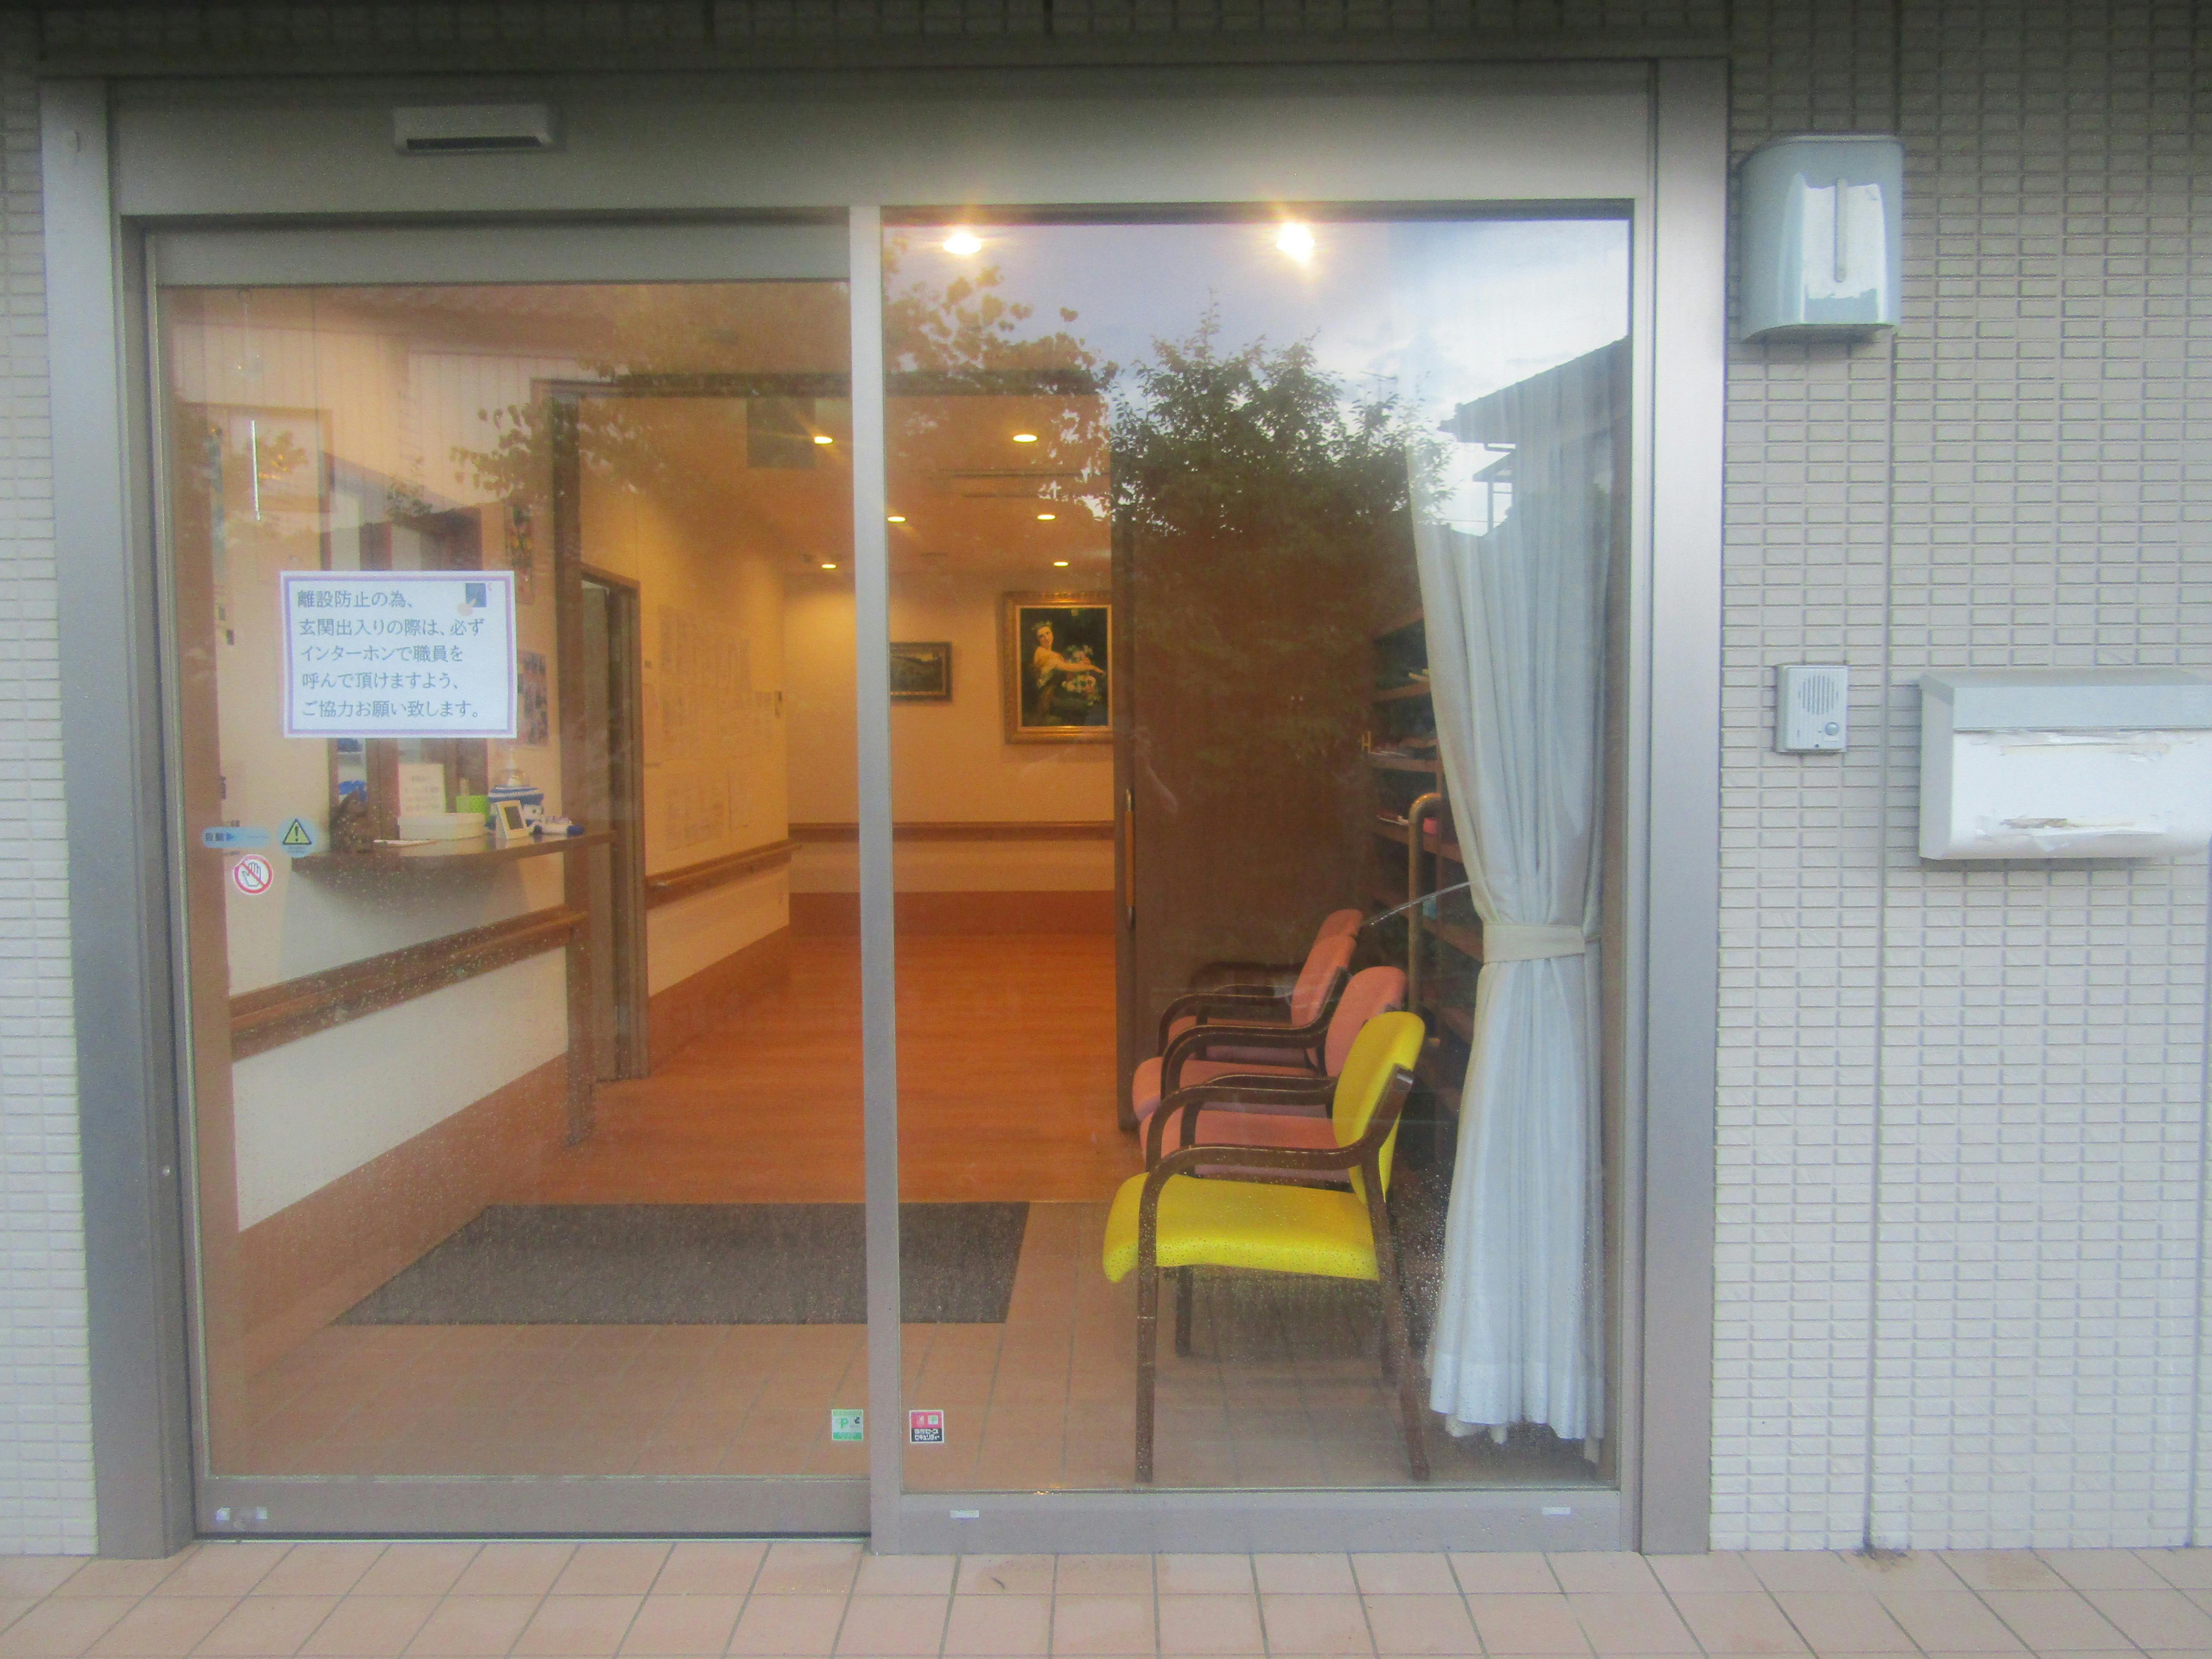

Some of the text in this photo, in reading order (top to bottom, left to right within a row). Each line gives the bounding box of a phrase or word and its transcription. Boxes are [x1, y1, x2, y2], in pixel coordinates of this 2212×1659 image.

[297, 590, 413, 608] 離設防止の為、
[299, 618, 484, 636] 玄関出入りの際は、必ず
[301, 645, 463, 662] インターホンで職員を
[302, 672, 458, 690] 呼んで頂けますよう、
[303, 700, 479, 718] ご協力お願い致します。
